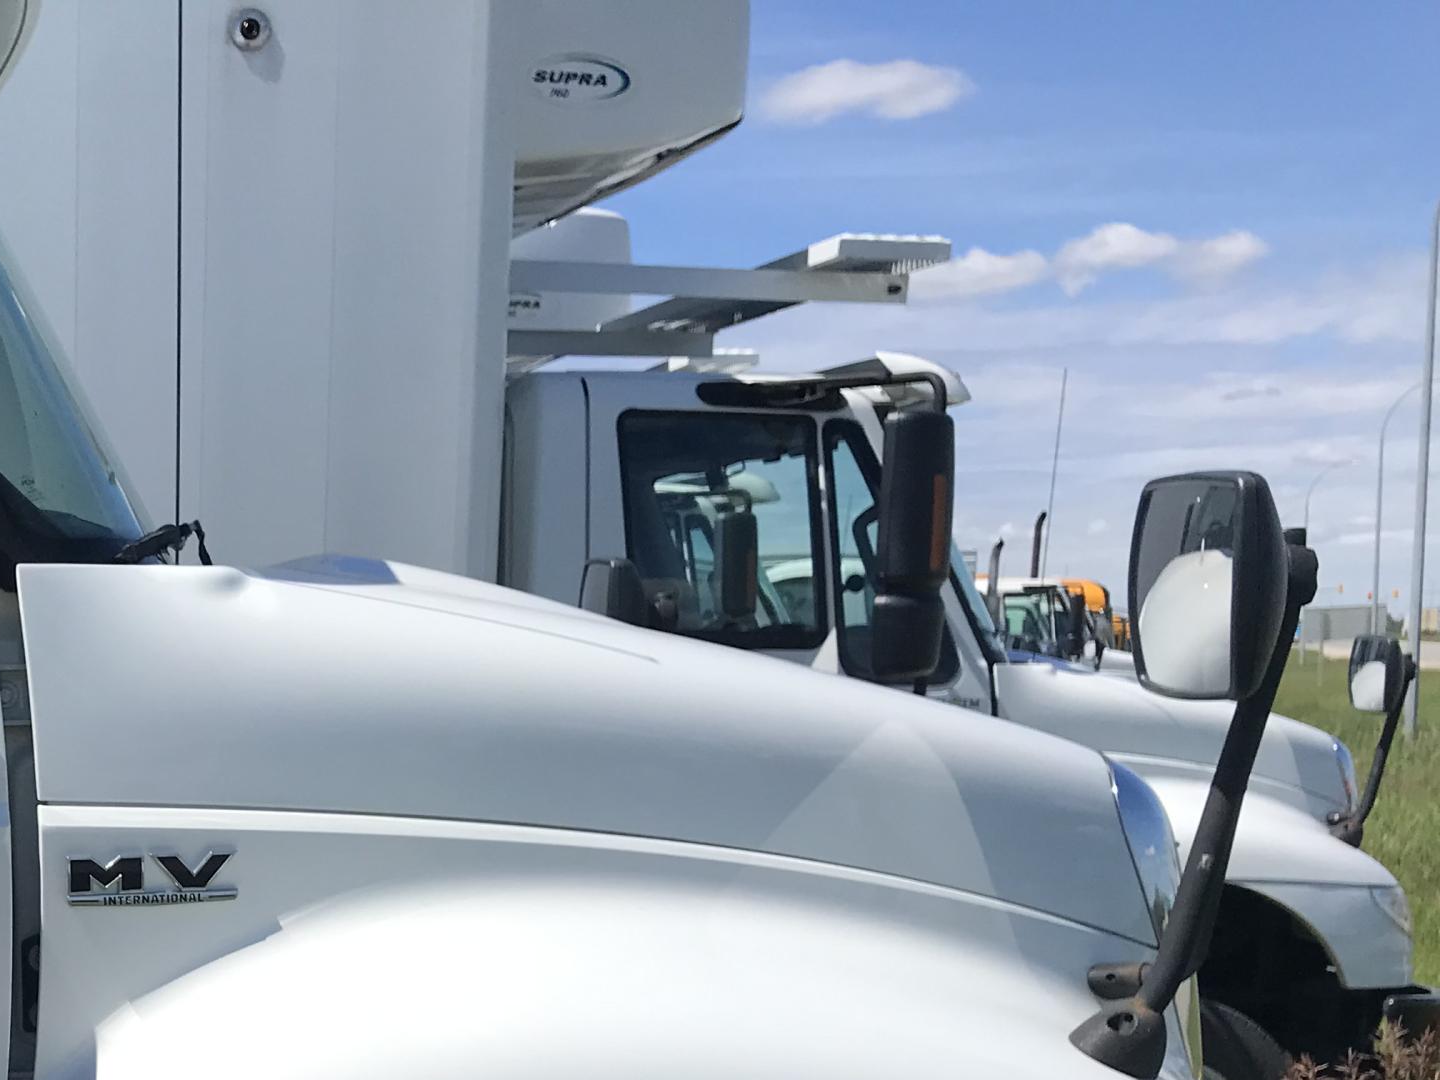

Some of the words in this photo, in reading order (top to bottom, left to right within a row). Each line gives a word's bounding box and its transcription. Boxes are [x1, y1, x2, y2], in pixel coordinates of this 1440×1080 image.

[532, 69, 608, 87] SUPRA
[67, 851, 237, 894] MV
[103, 893, 205, 906] INTERNATIONAL
